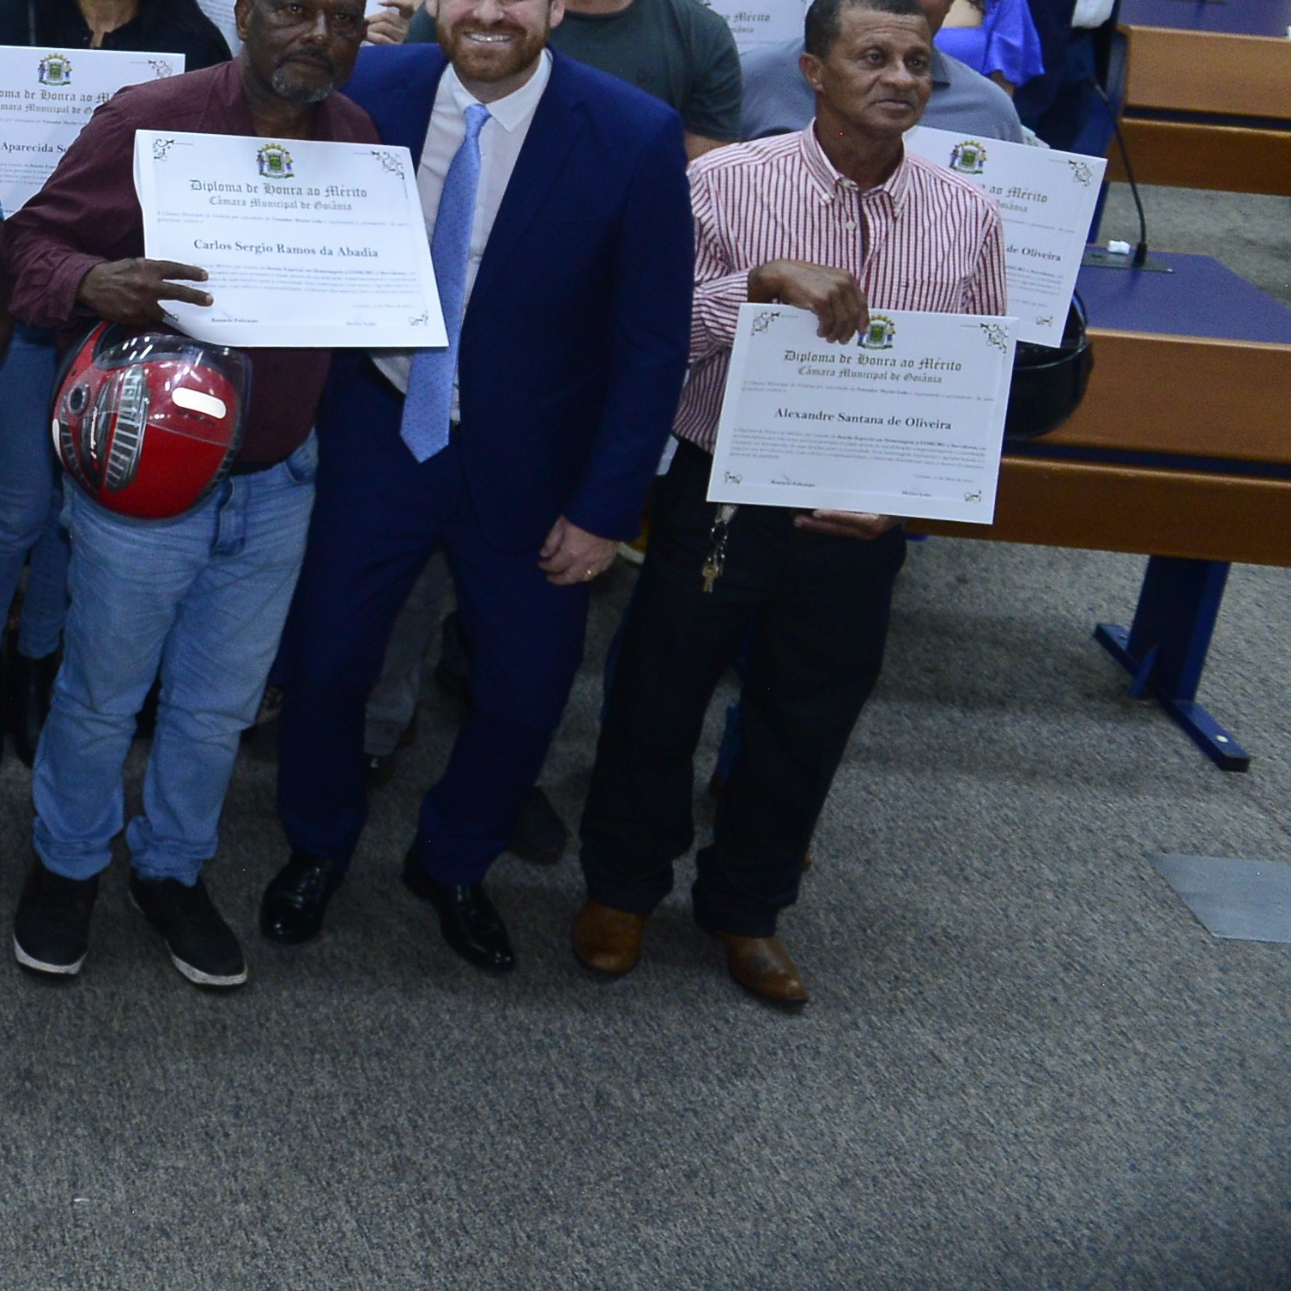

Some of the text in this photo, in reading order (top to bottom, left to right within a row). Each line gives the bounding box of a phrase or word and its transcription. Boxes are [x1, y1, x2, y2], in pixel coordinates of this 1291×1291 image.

[0, 141, 53, 154] Aparecida
[190, 179, 242, 194] Diploma
[246, 183, 258, 194] de
[307, 186, 320, 197] ao
[250, 196, 297, 210] Municipal
[300, 201, 311, 210] de
[193, 239, 378, 257] Carlos Sergio Ramos da Abadia
[784, 349, 835, 364] Diploma
[839, 353, 851, 364] de
[901, 358, 914, 368] ao
[839, 367, 887, 381] Municipal
[890, 372, 901, 380] de
[774, 408, 952, 430] Alexandre Santana de Oliveira
